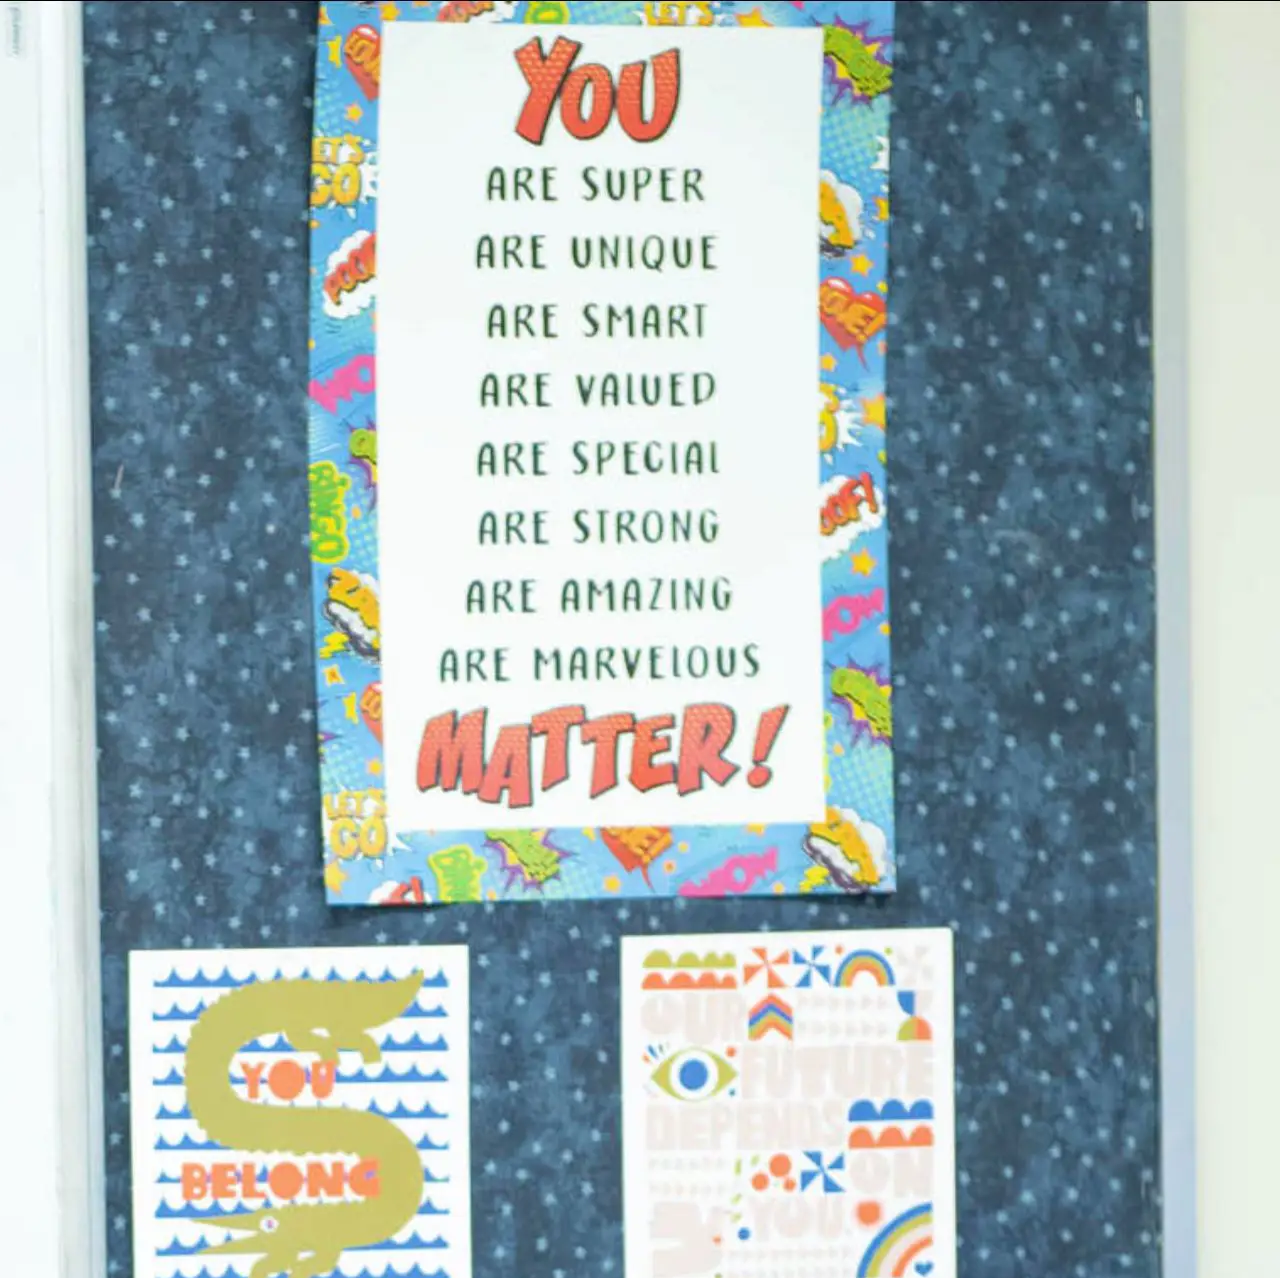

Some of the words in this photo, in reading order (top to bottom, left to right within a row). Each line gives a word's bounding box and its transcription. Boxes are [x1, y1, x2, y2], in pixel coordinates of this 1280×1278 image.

[513, 35, 682, 146] YOU
[487, 167, 558, 202] ARE
[581, 166, 705, 202] SUPER
[476, 235, 546, 269] ARE
[571, 235, 717, 271] UNIQUE
[487, 304, 558, 338] ARE
[582, 304, 706, 338] SMART
[480, 373, 550, 407] ARE
[576, 372, 716, 407] VALUED
[477, 442, 547, 476] ARE
[572, 441, 719, 476] SPECIAL
[478, 510, 548, 545] ARE
[573, 509, 719, 544] STRONG
[466, 579, 535, 613] ARE
[560, 577, 731, 613] AMAZING
[440, 648, 509, 682] ARE
[534, 643, 760, 681] MARVELOUS
[416, 703, 791, 809] MATTER!
[324, 788, 387, 820] LET'S
[329, 816, 387, 859] GO
[241, 1059, 336, 1101] YOU
[741, 1043, 934, 1099] FUTURE
[646, 1101, 846, 1151] DEPENDS
[181, 1156, 382, 1201] BELONG
[849, 1150, 934, 1198] ON
